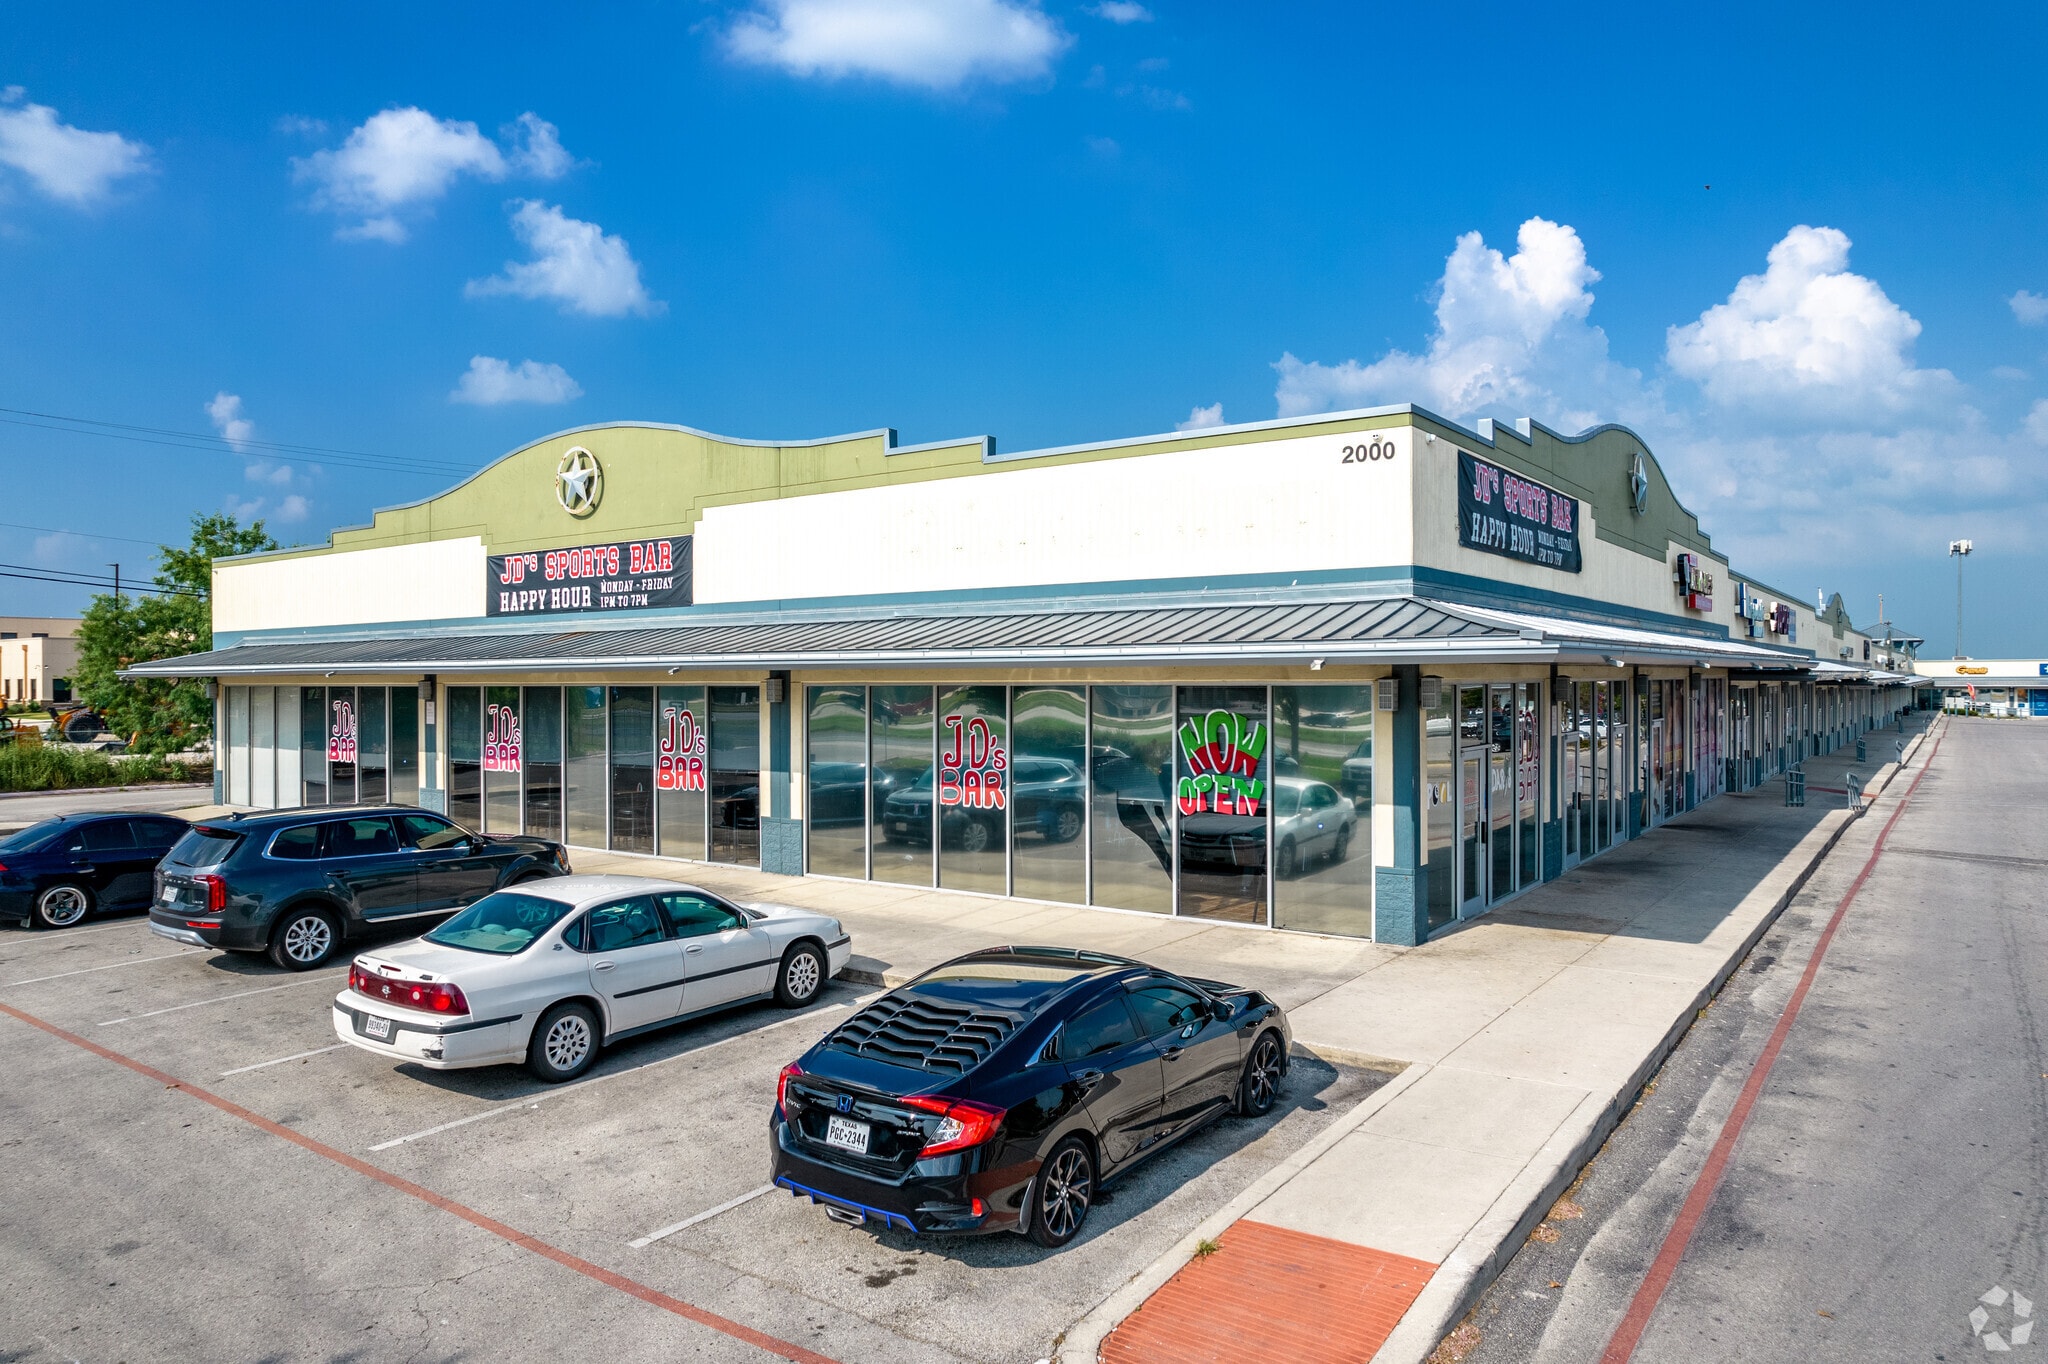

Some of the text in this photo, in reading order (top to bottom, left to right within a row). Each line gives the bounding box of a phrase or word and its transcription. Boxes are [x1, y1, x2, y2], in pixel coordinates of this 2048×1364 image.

[1342, 441, 1395, 464] 2000
[1503, 474, 1548, 525] SPORTS
[1551, 493, 1573, 533] BAR
[1471, 512, 1535, 556] HAPPY HOUR
[545, 545, 620, 581] SPORTS
[629, 540, 673, 575] BAR
[500, 586, 592, 612] HAPPY HOUR
[600, 579, 634, 594] MONDAY
[641, 577, 674, 591] FRIDAY
[600, 594, 648, 608] 1PM TO 7PM
[329, 737, 357, 763] BAR
[485, 743, 521, 772] BAR
[1178, 709, 1267, 778] NOW
[658, 755, 705, 791] BAR
[940, 768, 1006, 810] BAR
[1519, 765, 1539, 802] BAR
[1178, 774, 1264, 816] OPEN
[841, 1120, 858, 1130] TEXAS
